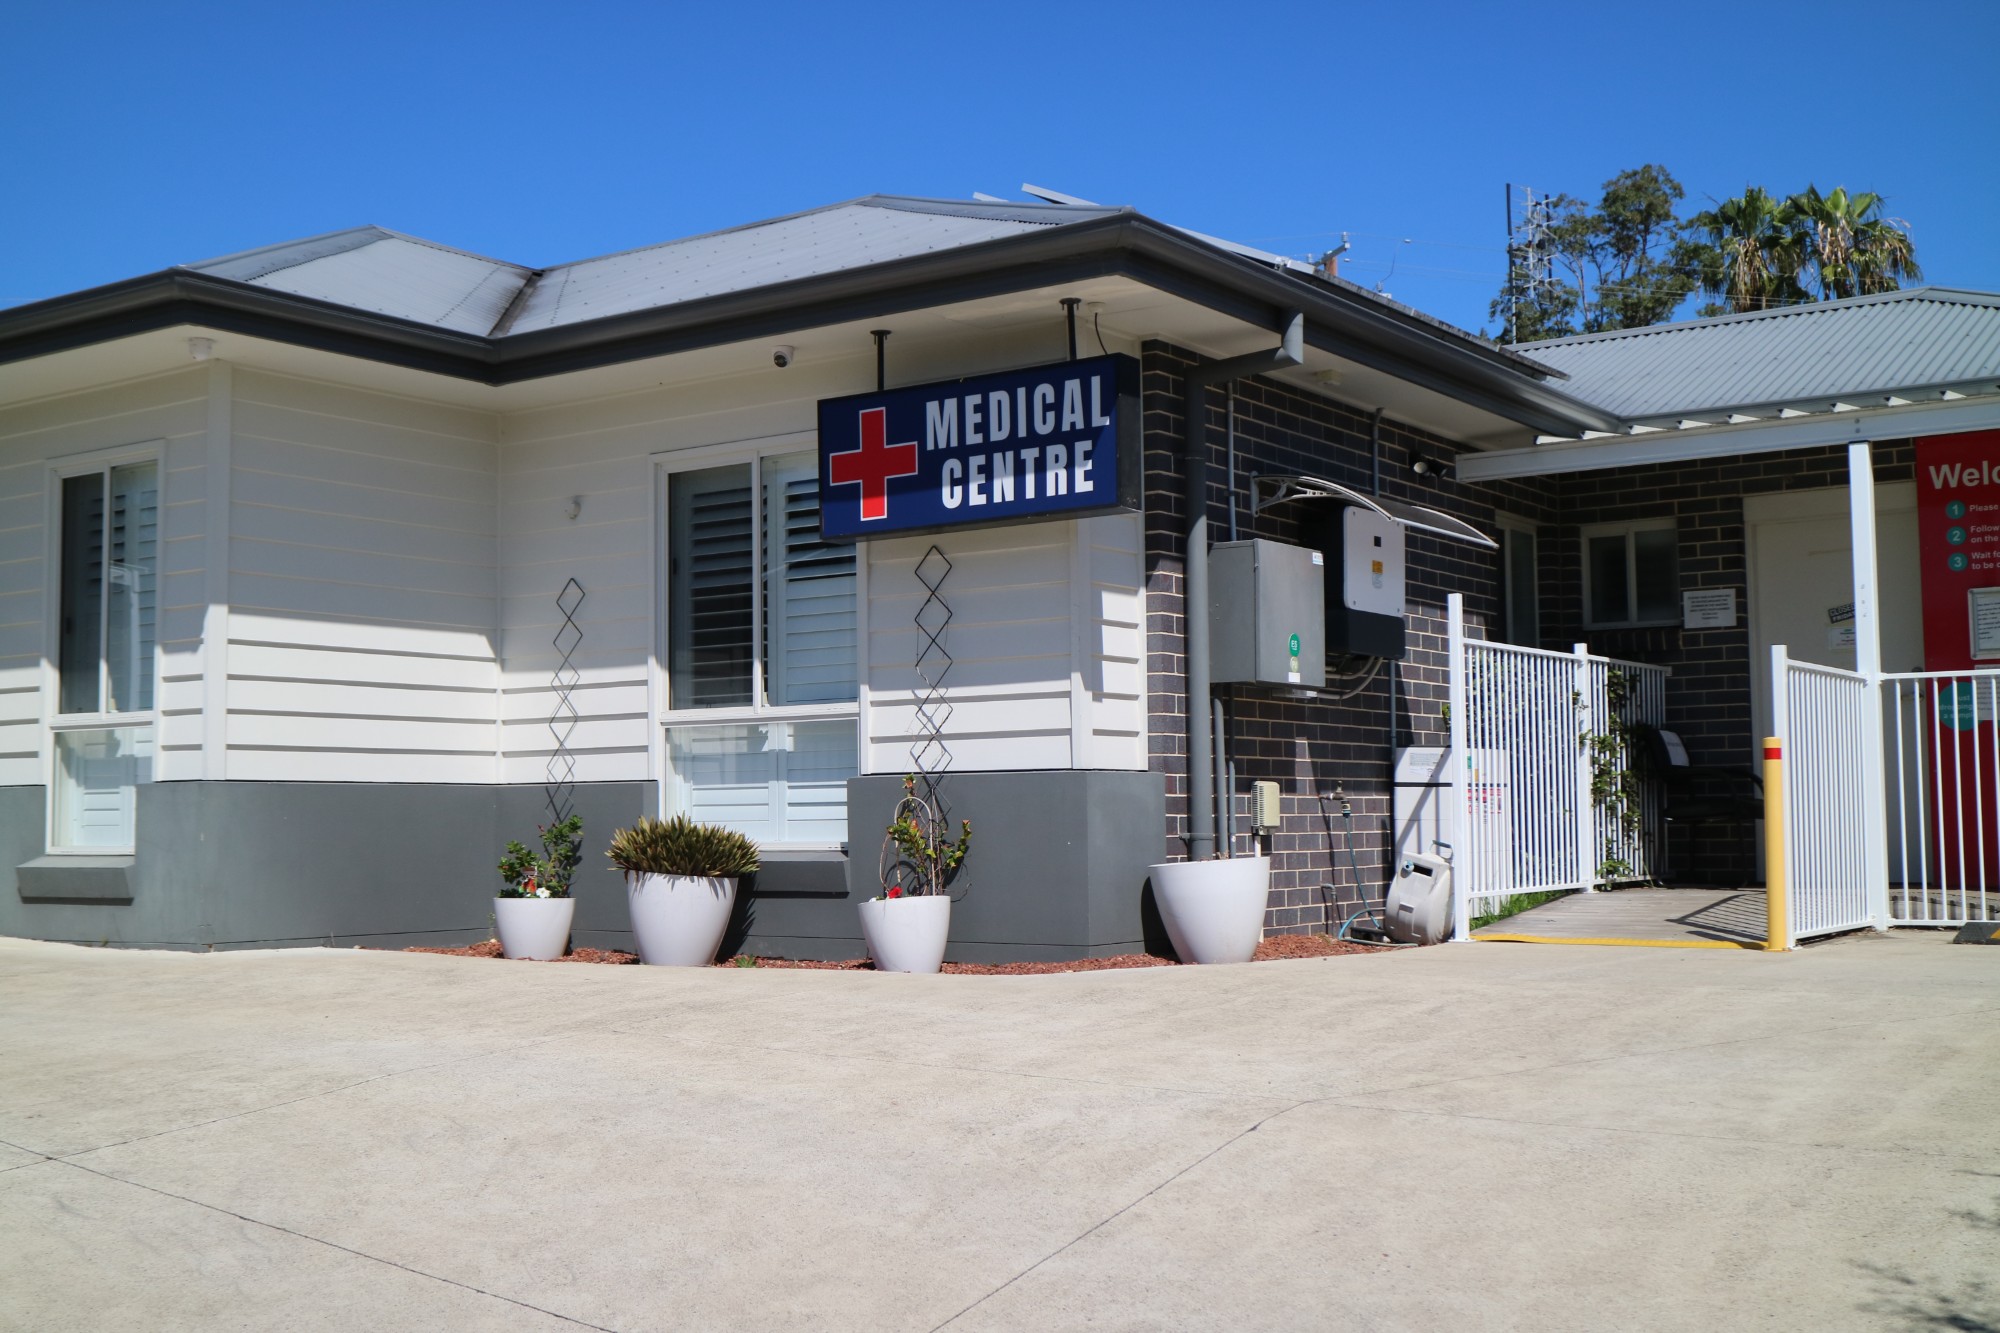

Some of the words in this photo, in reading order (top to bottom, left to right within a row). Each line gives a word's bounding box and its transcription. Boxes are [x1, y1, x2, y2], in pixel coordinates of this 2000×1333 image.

[926, 375, 1110, 450] MEDICAL
[941, 440, 1094, 509] CENTRE
[1969, 504, 1999, 512] Please
[1970, 525, 2000, 533] Follow
[1971, 551, 1991, 560] Wait
[1972, 562, 1981, 570] to
[1983, 561, 1994, 569] be
[1950, 712, 1974, 720] smpl
